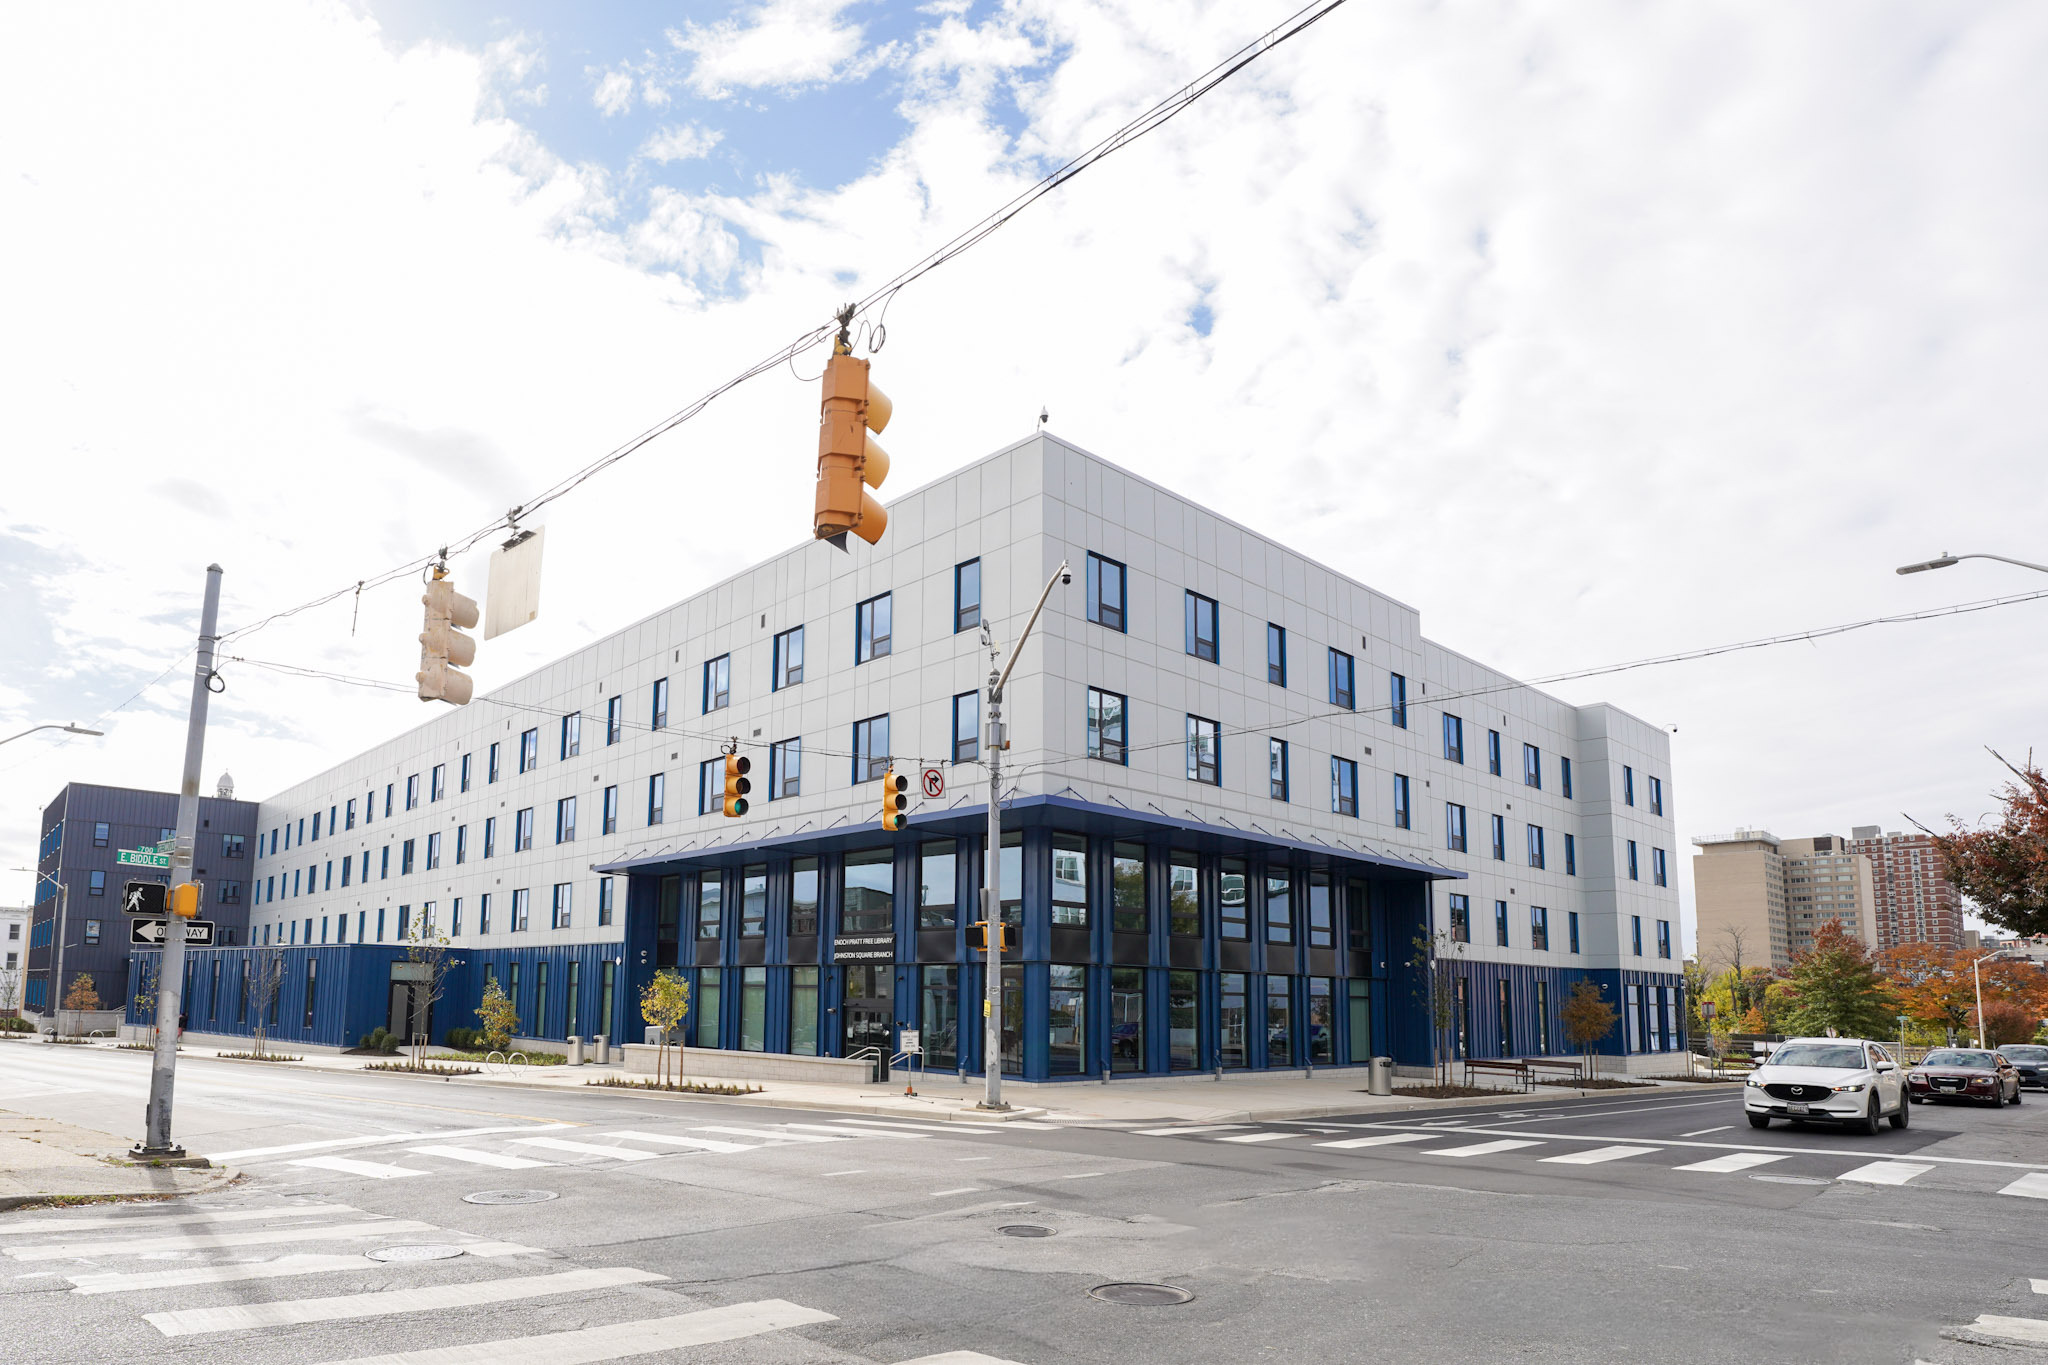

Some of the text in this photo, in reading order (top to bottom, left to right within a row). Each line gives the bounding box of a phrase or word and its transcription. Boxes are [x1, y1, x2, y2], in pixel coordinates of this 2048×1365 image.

[120, 852, 127, 862] E.
[130, 853, 158, 865] BIDDLE
[834, 952, 855, 960] JOHNSTON
[856, 951, 873, 960] SQUARE
